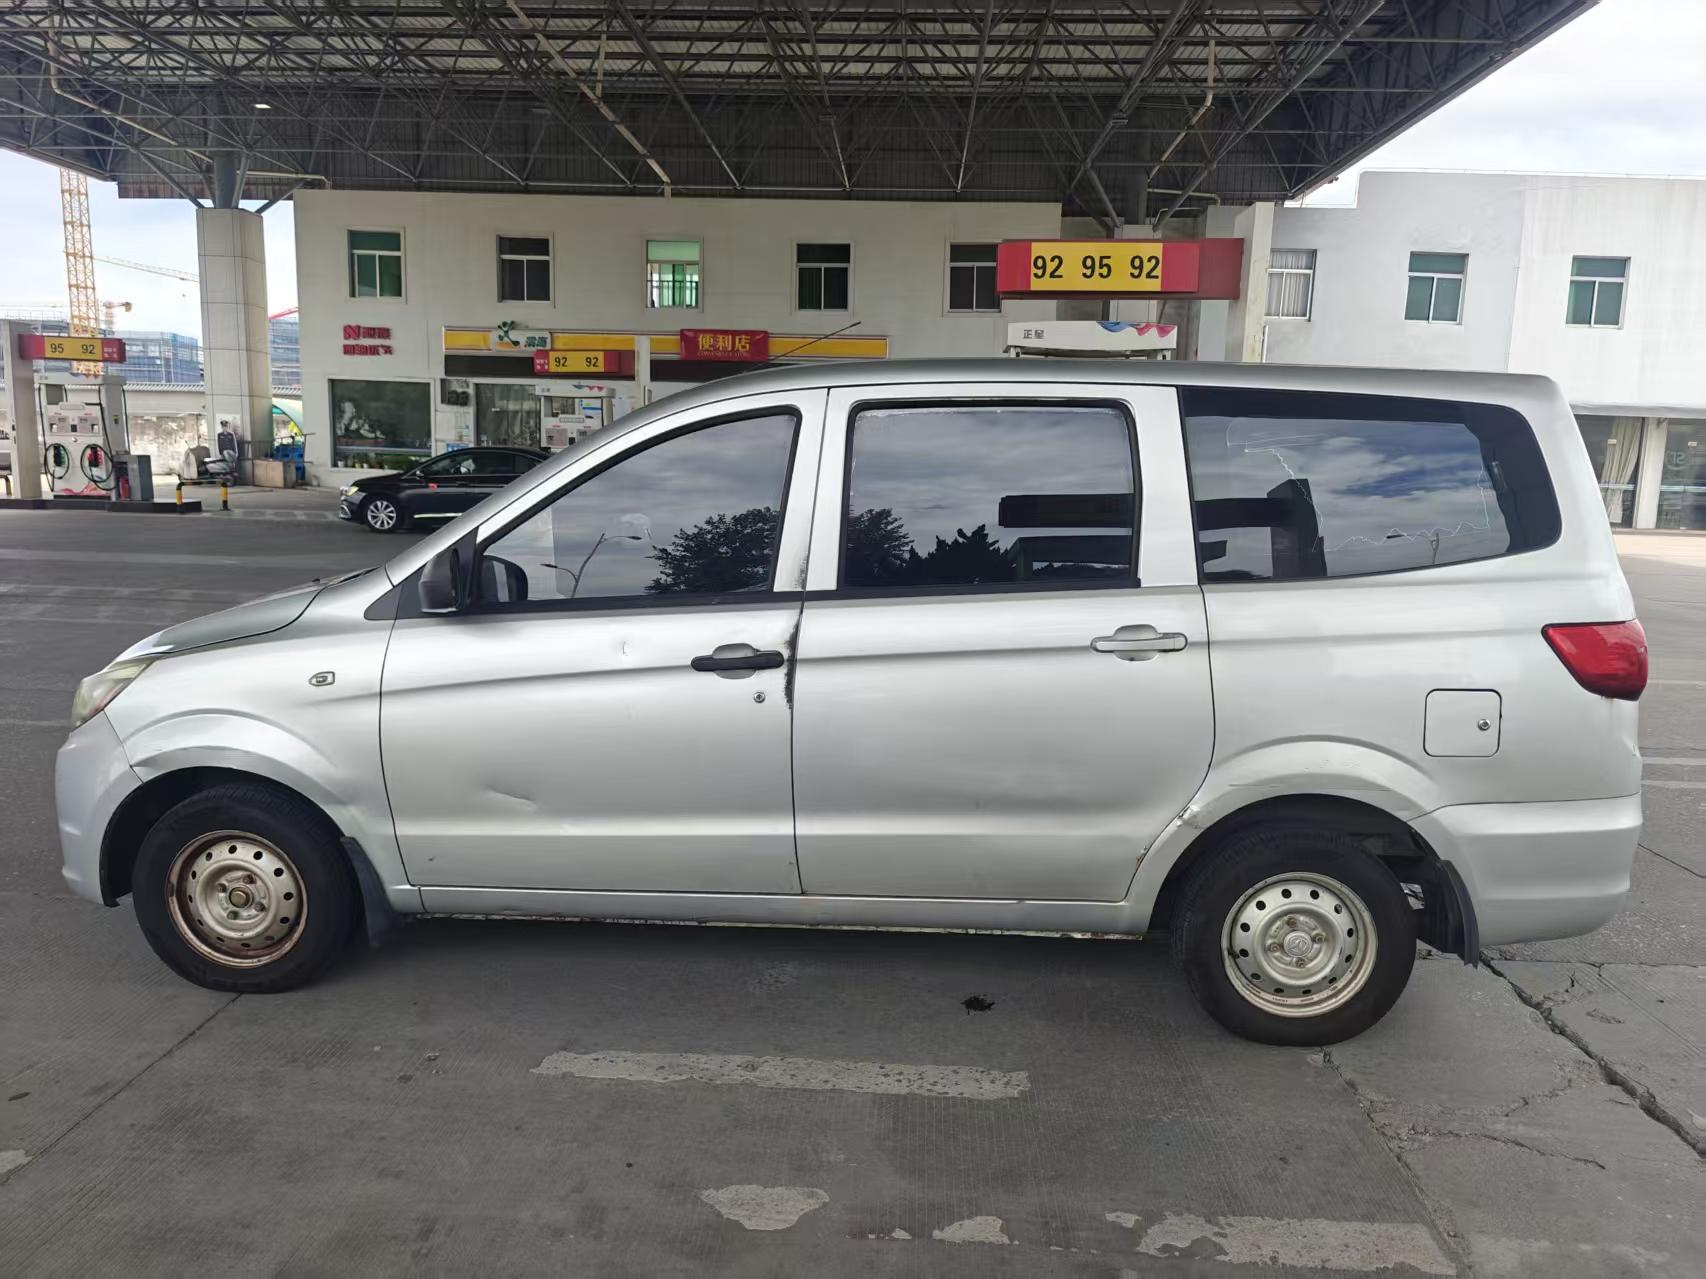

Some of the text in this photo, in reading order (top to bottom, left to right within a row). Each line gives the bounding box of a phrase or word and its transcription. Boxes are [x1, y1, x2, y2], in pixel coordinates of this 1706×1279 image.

[1033, 255, 1160, 279] 92 95 92
[50, 343, 64, 353] 95
[81, 344, 96, 354] 92
[698, 334, 751, 352] 便利店
[554, 357, 568, 367] 92
[585, 357, 599, 367] 92
